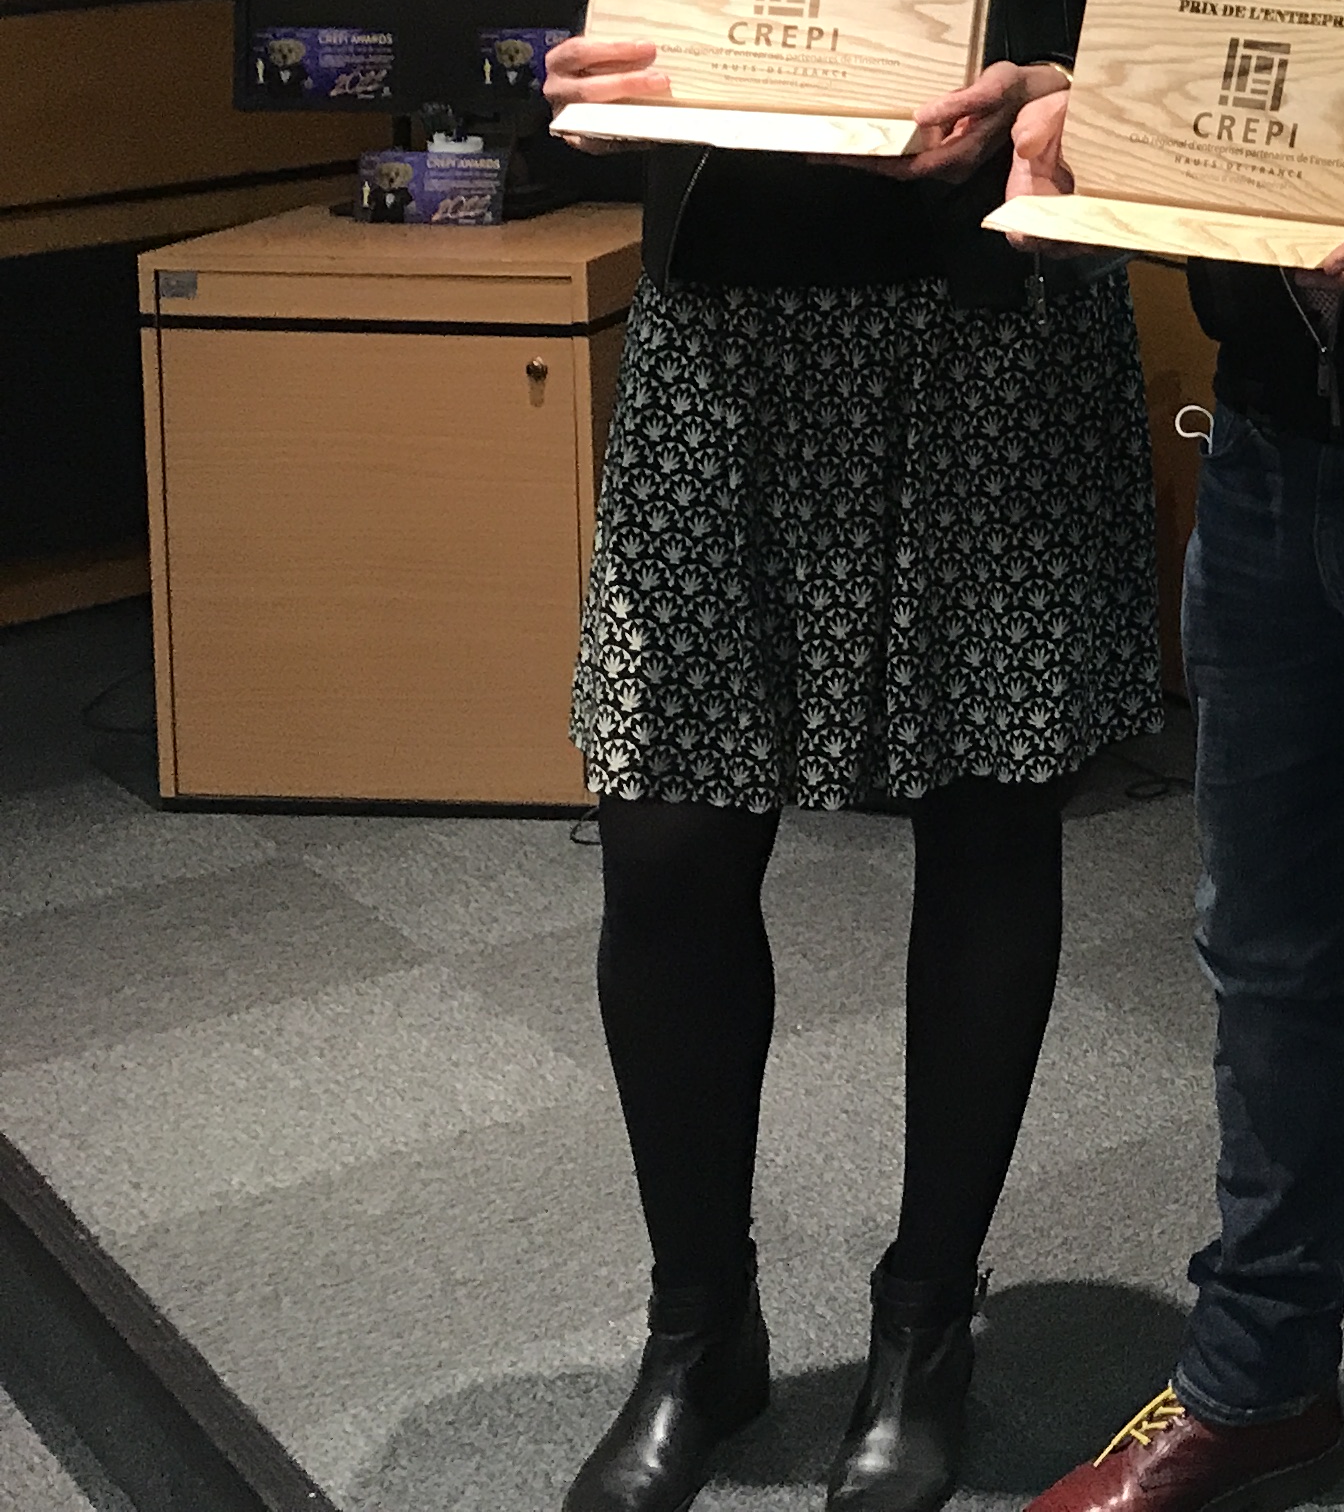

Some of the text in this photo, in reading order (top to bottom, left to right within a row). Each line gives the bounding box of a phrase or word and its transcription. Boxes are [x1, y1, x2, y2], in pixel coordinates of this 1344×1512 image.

[1178, 0, 1219, 16] PRIX
[1222, 4, 1247, 19] DE
[728, 21, 839, 52] CREPI
[1193, 112, 1298, 149] CREPI
